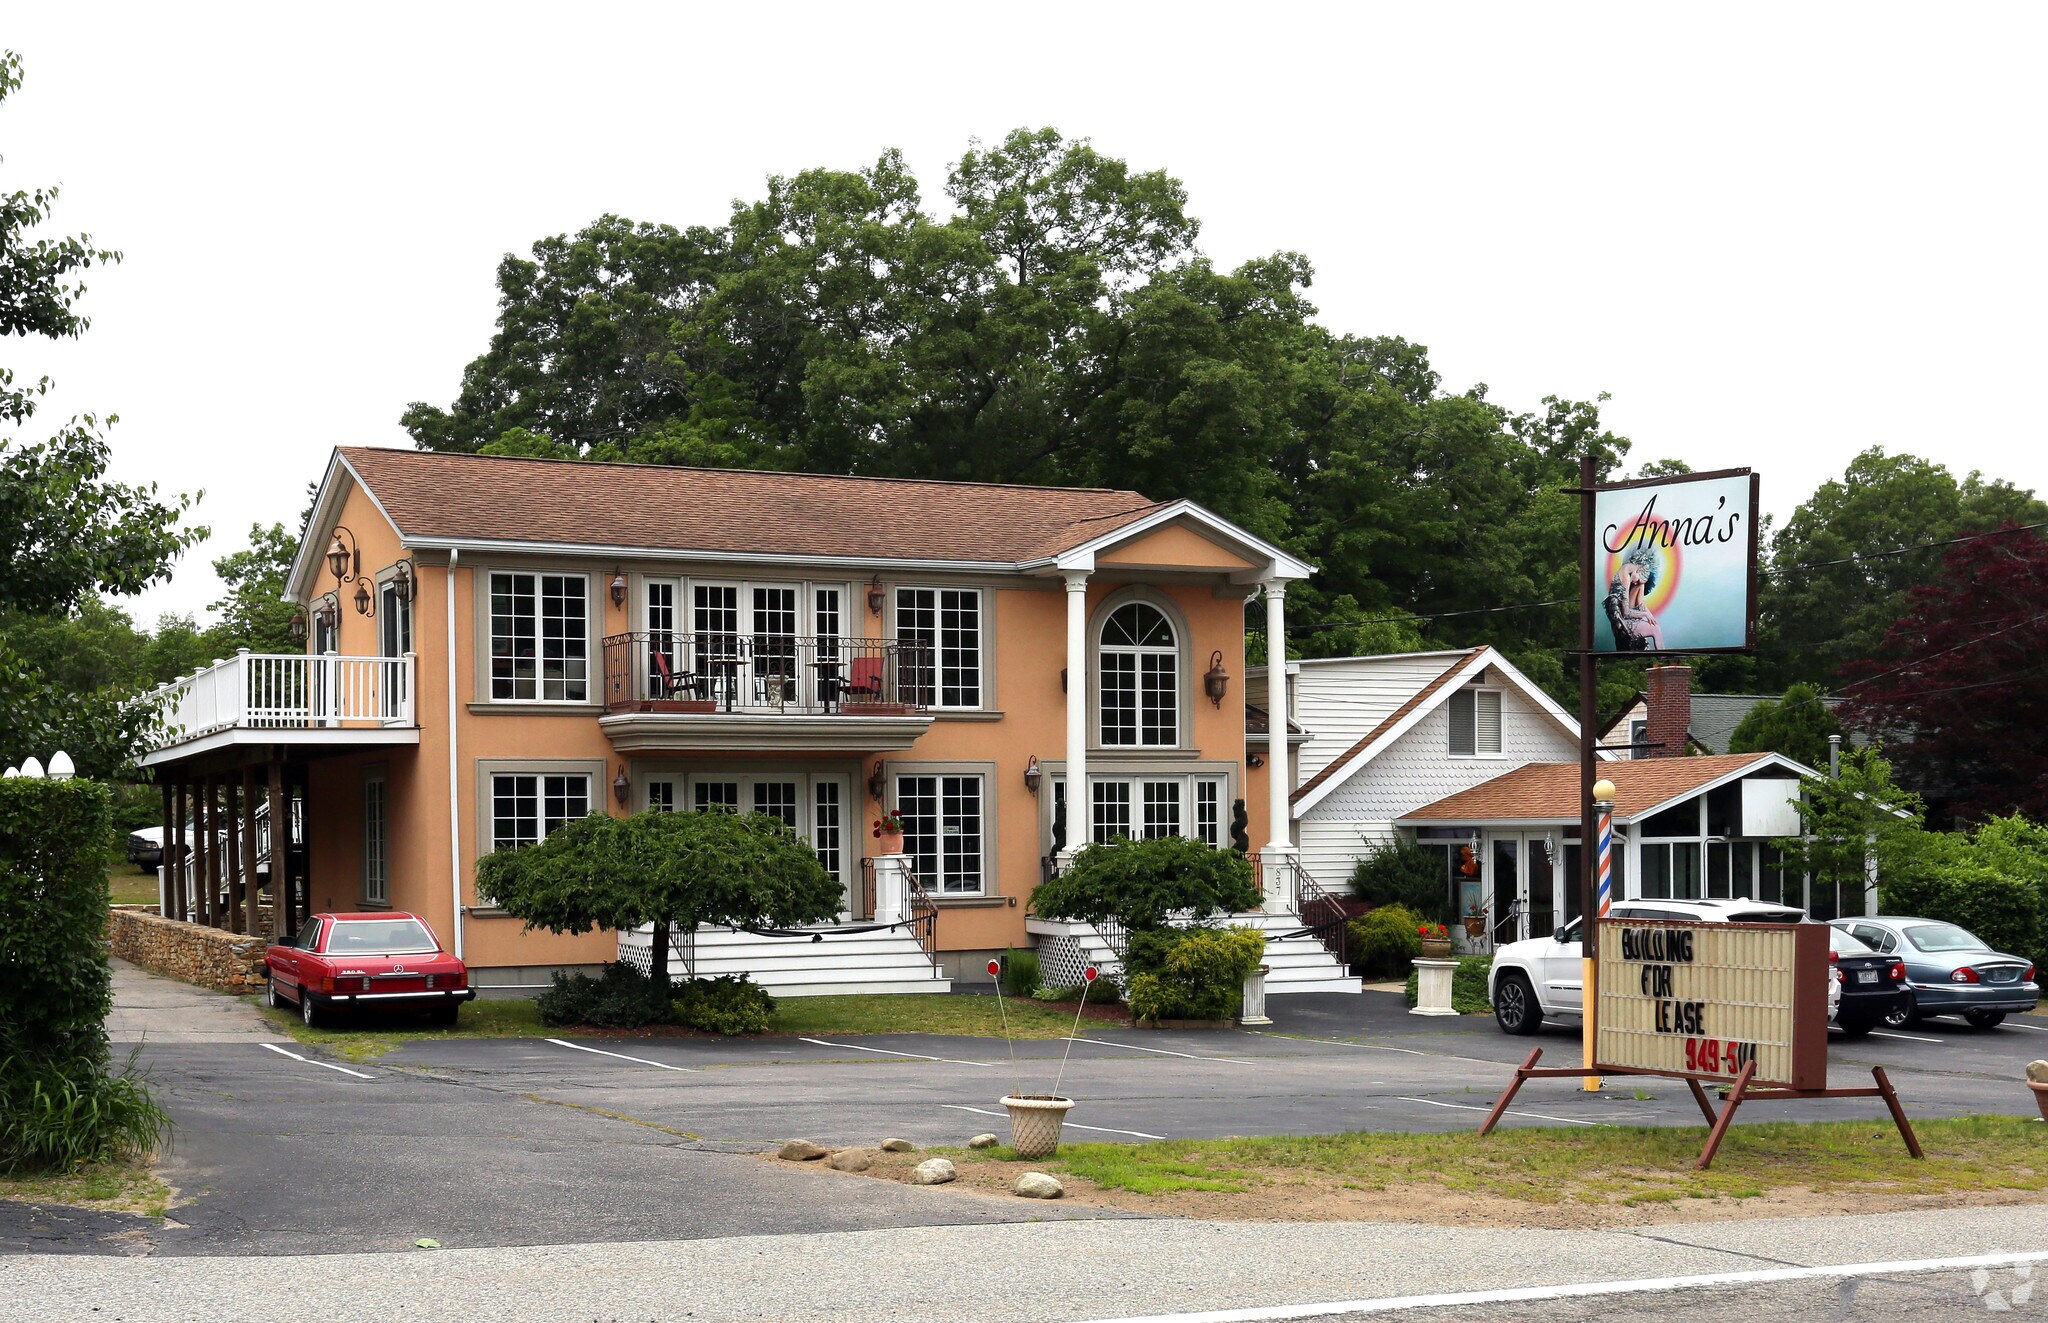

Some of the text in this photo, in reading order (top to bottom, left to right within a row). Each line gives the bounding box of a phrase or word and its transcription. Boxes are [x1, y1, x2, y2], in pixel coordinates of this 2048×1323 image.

[1602, 494, 1740, 553] Anna's
[1622, 928, 1693, 962] BUILDING
[1641, 964, 1672, 997] FOR
[1655, 1000, 1705, 1035] LEASE
